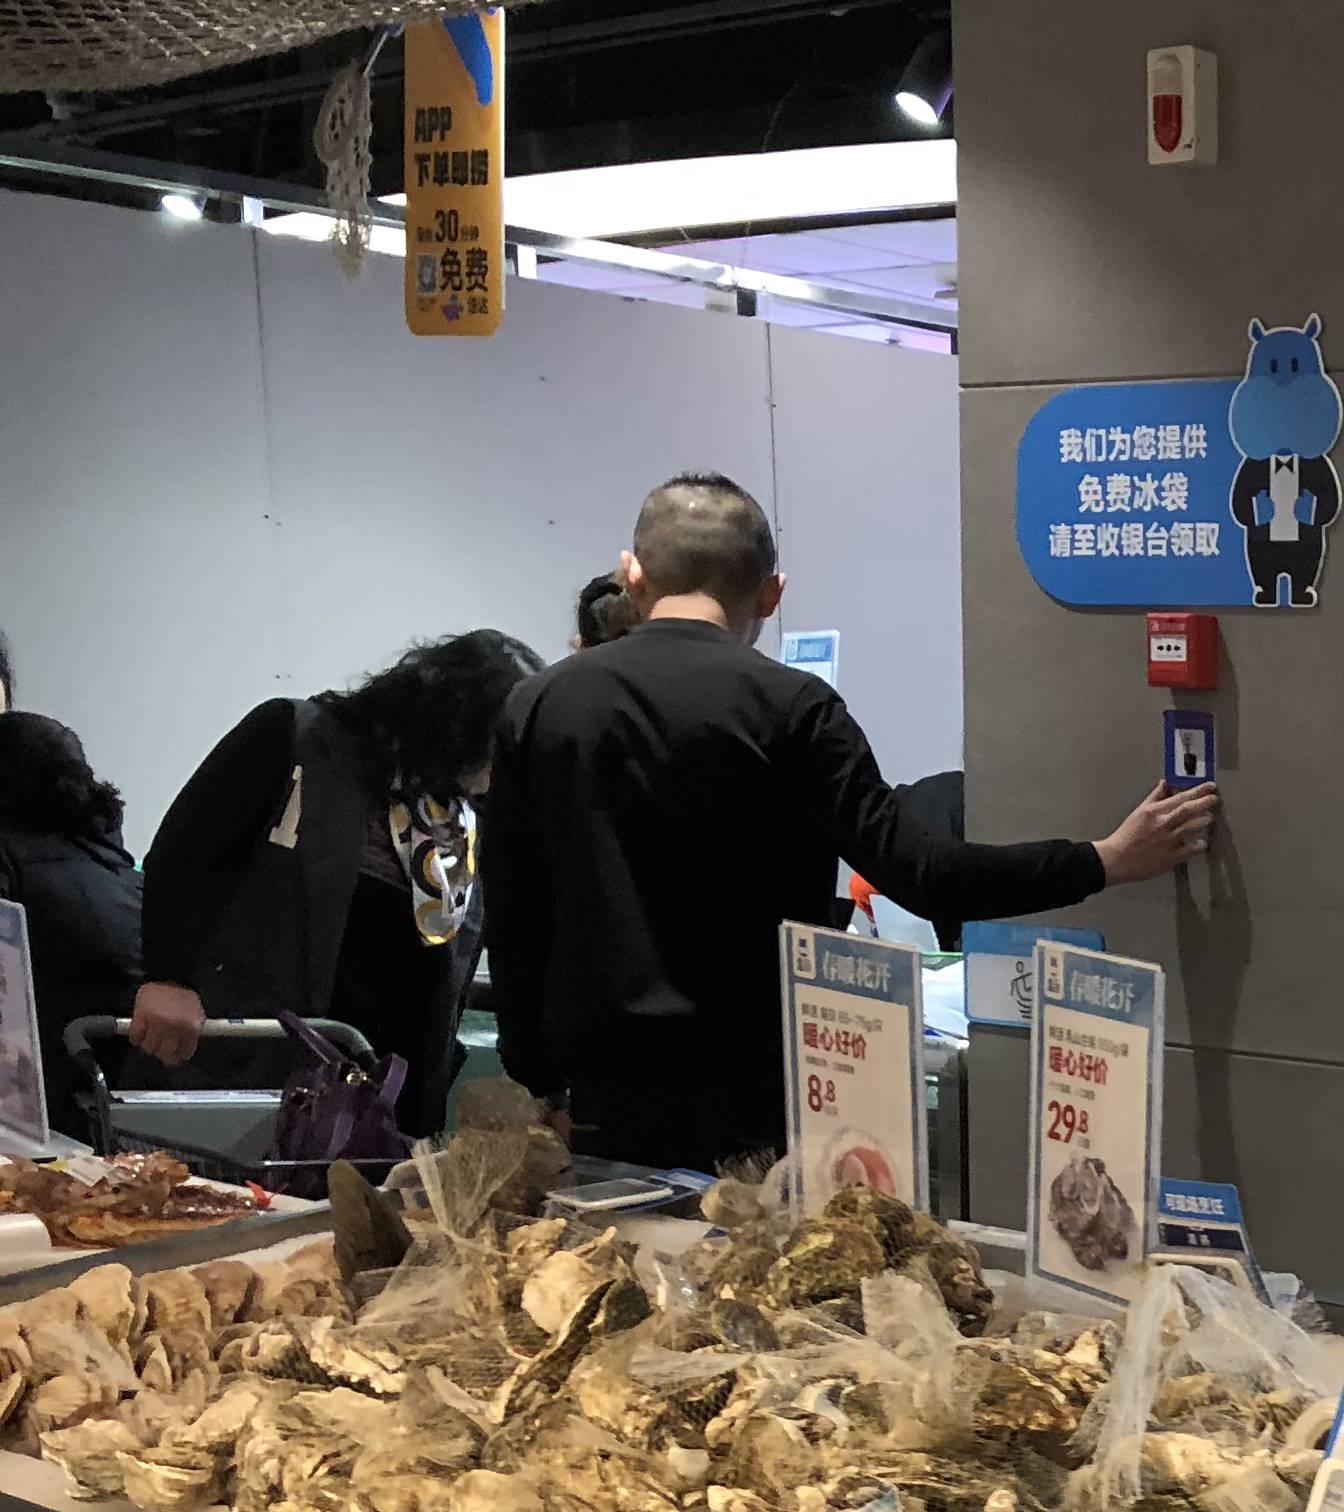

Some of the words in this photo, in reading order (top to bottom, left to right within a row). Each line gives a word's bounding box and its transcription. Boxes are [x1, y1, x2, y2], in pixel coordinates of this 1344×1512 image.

[415, 106, 452, 142] APP
[440, 247, 488, 292] 免费
[1059, 424, 1207, 463] 我们为您提供
[1078, 472, 1189, 512] 免费冰袋
[1049, 522, 1220, 558] 请至收银台领取
[802, 1022, 867, 1060] 暖心好价
[1049, 1046, 1109, 1085] 暖心好价
